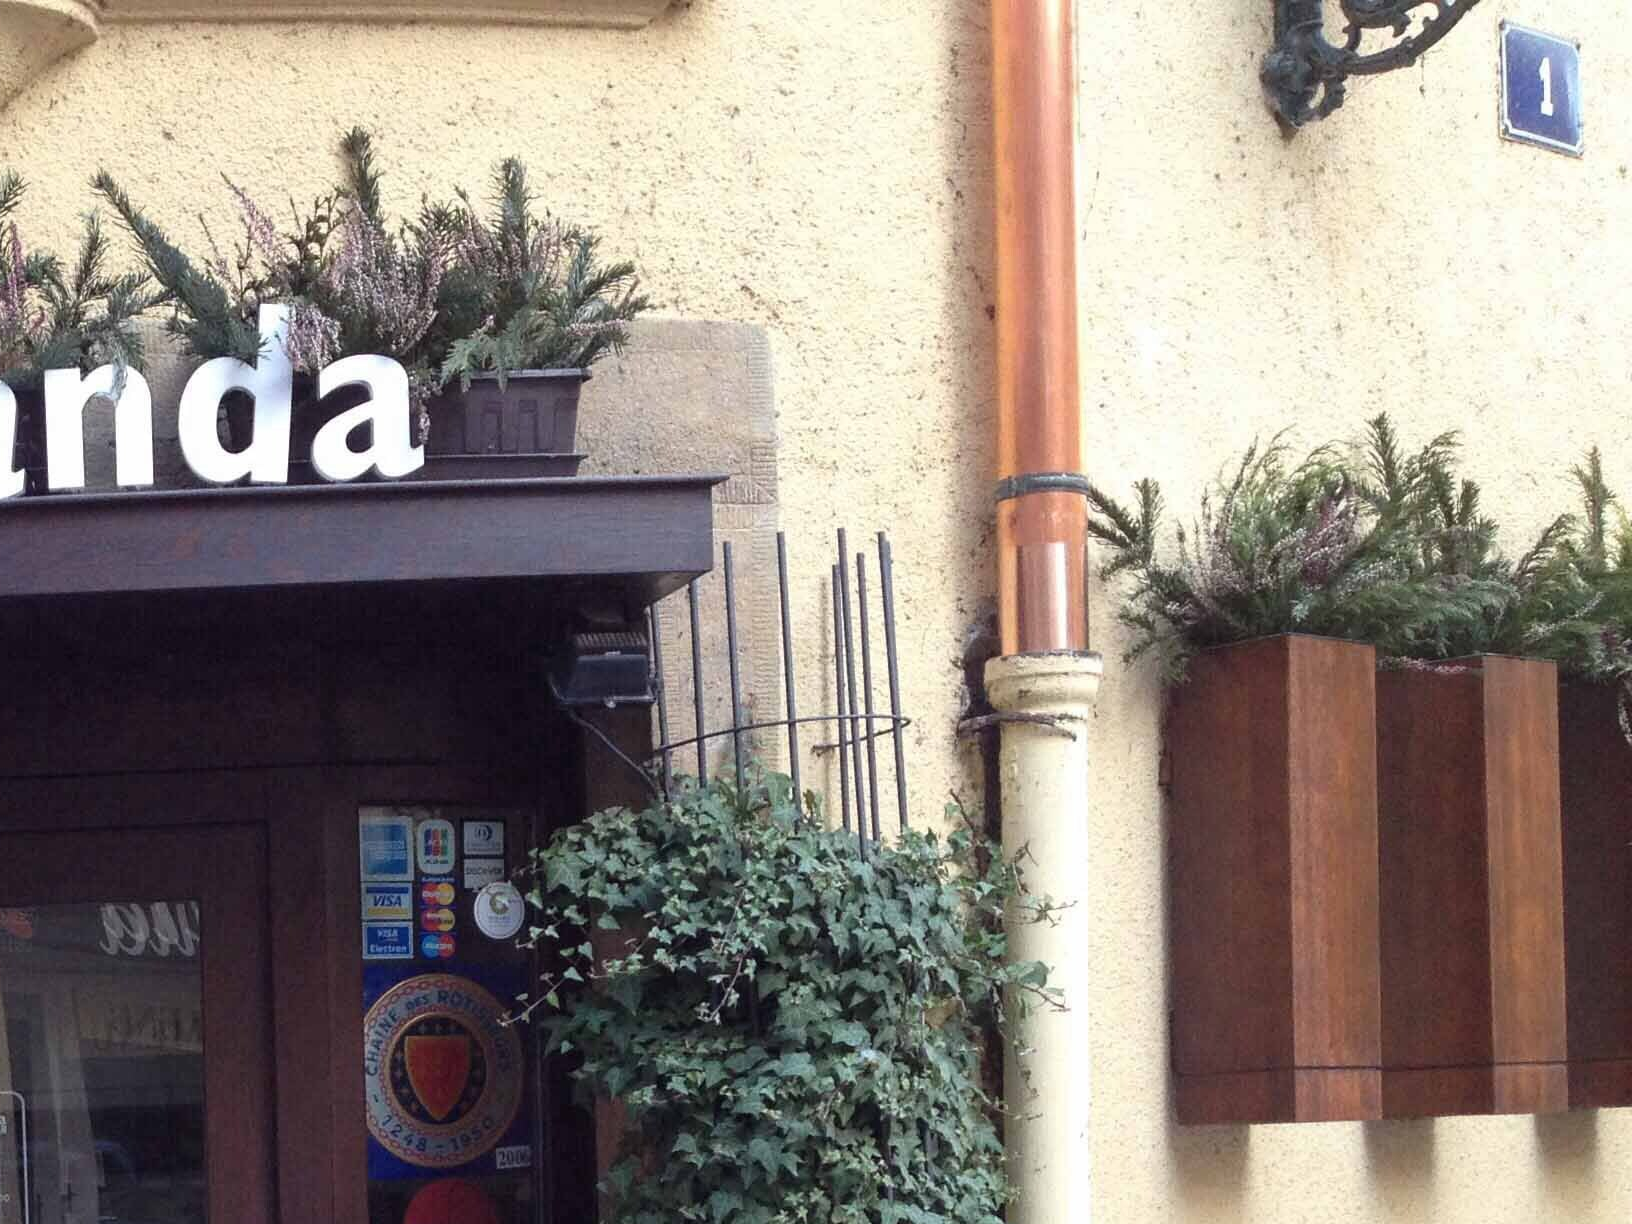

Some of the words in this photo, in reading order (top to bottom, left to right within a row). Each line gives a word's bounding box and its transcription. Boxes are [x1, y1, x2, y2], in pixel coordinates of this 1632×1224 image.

[1537, 56, 1554, 117] 1
[374, 895, 402, 907] VISA
[377, 929, 399, 938] VISA
[370, 944, 407, 953] Electron
